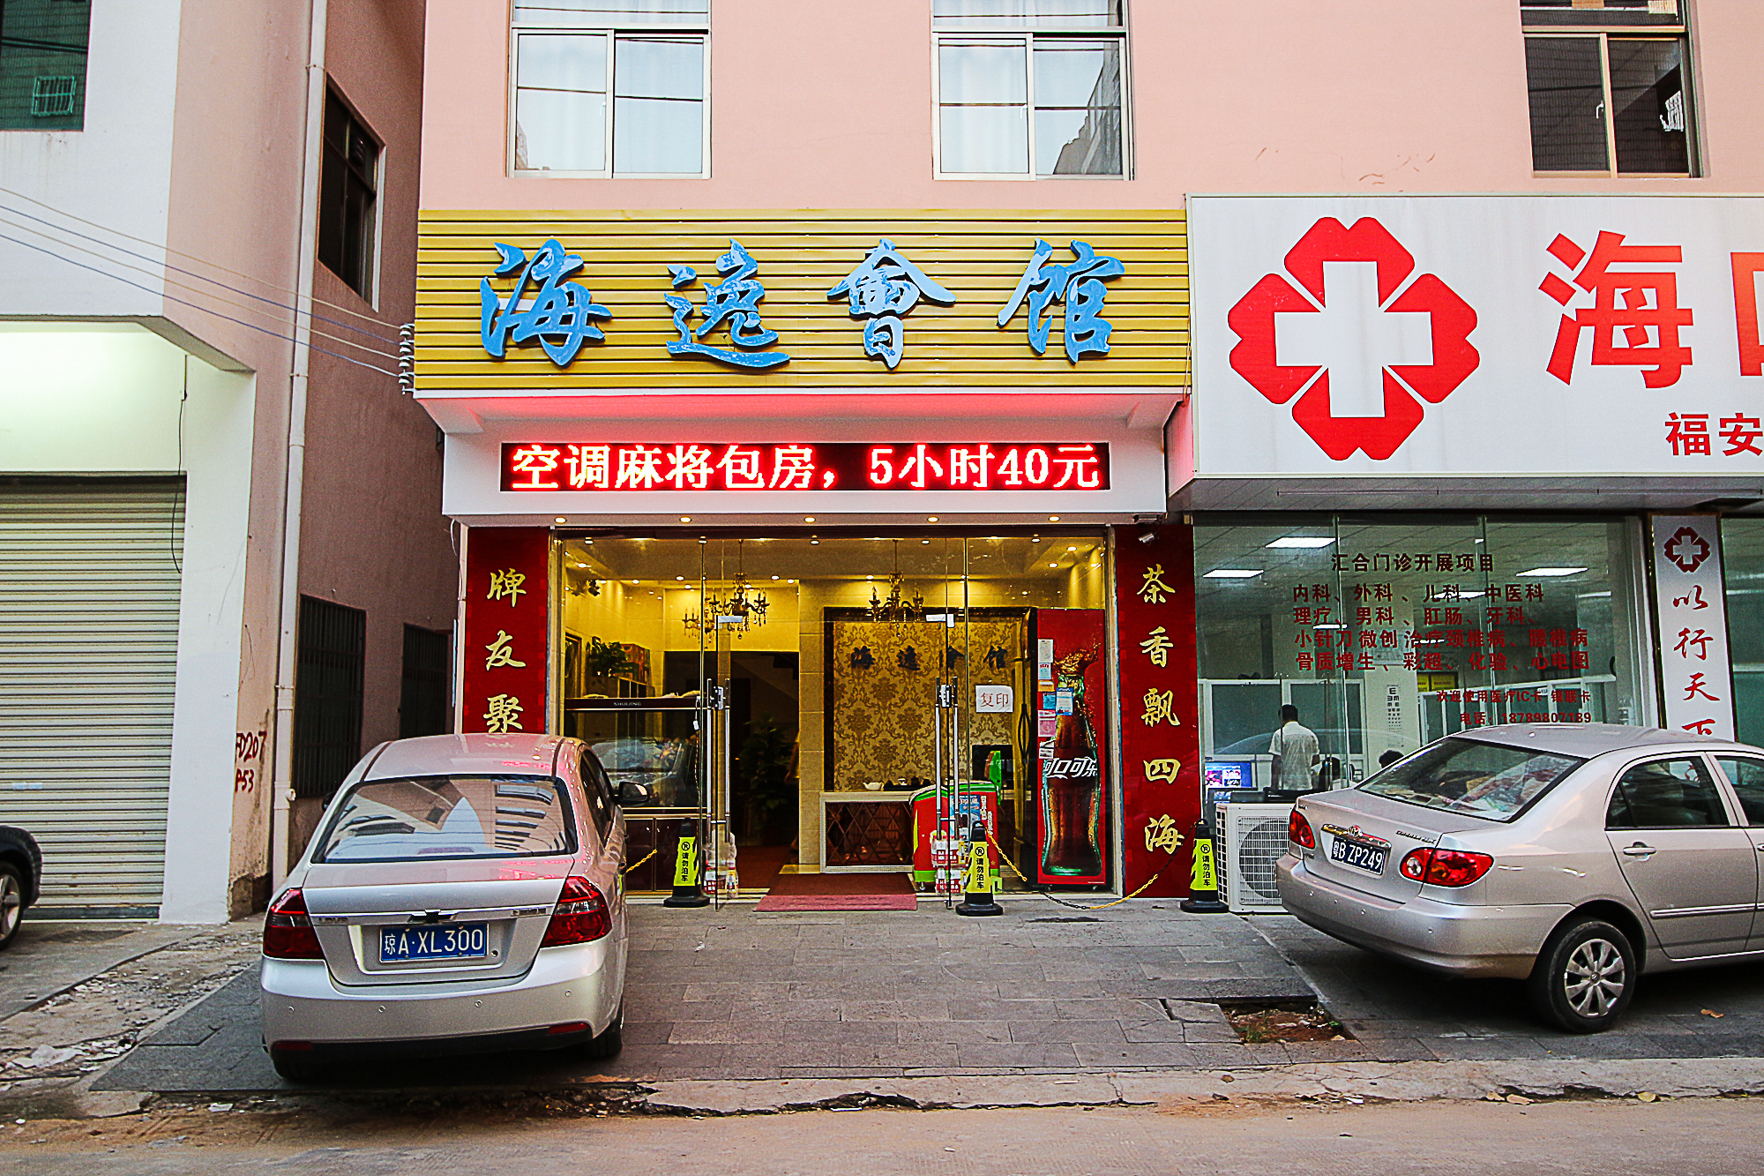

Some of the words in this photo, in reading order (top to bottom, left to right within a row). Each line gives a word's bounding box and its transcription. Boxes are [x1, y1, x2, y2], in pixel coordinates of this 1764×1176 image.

[1664, 411, 1764, 457] 福安
[1331, 553, 1493, 572] 汇合门诊开展项目
[980, 692, 1009, 708] 复印
[1137, 563, 1185, 855] 茶香飘四海
[1045, 756, 1098, 779] 可口可乐
